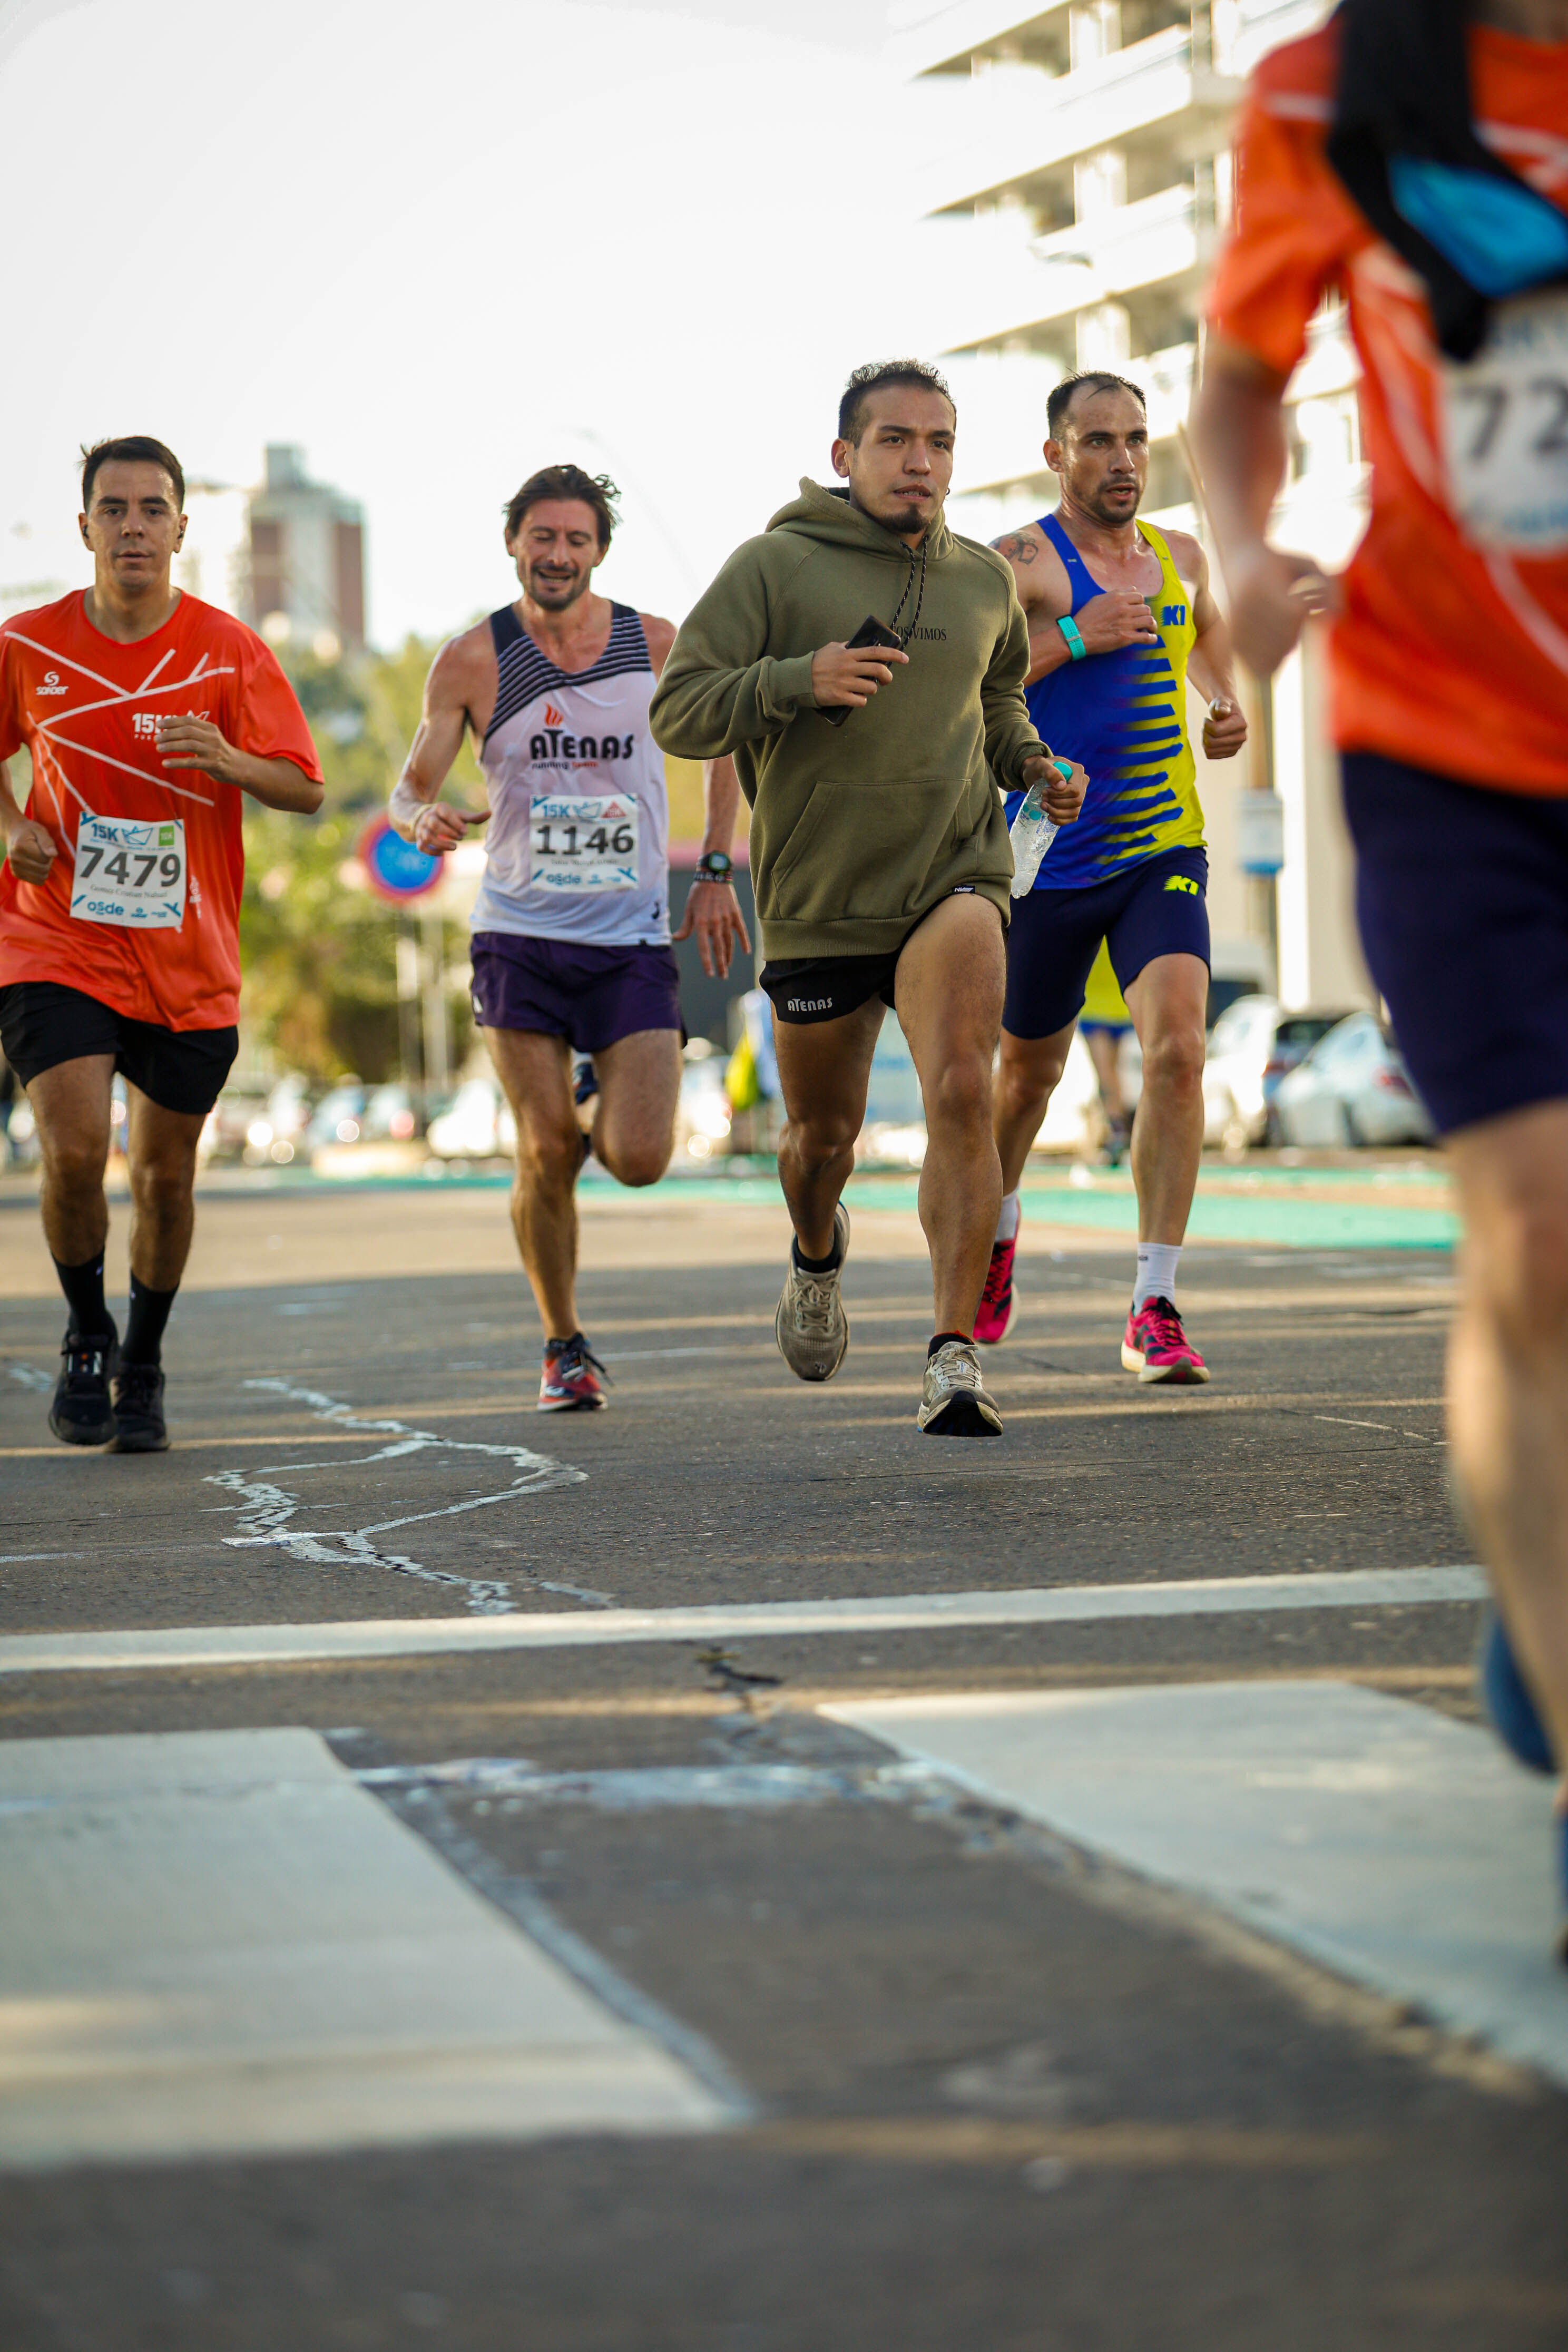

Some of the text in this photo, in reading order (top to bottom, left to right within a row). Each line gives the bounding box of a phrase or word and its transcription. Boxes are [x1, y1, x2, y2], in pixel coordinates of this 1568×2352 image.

[1161, 604, 1185, 626] K1
[912, 628, 947, 641] VIMOS
[530, 729, 634, 759] ATENAS
[542, 804, 570, 818] 15K
[91, 823, 118, 842] 15K
[536, 823, 634, 855] 1146
[80, 845, 181, 887] 7479
[1163, 875, 1199, 896] K1
[87, 901, 124, 915] osde
[787, 997, 832, 1011] ATENAS
